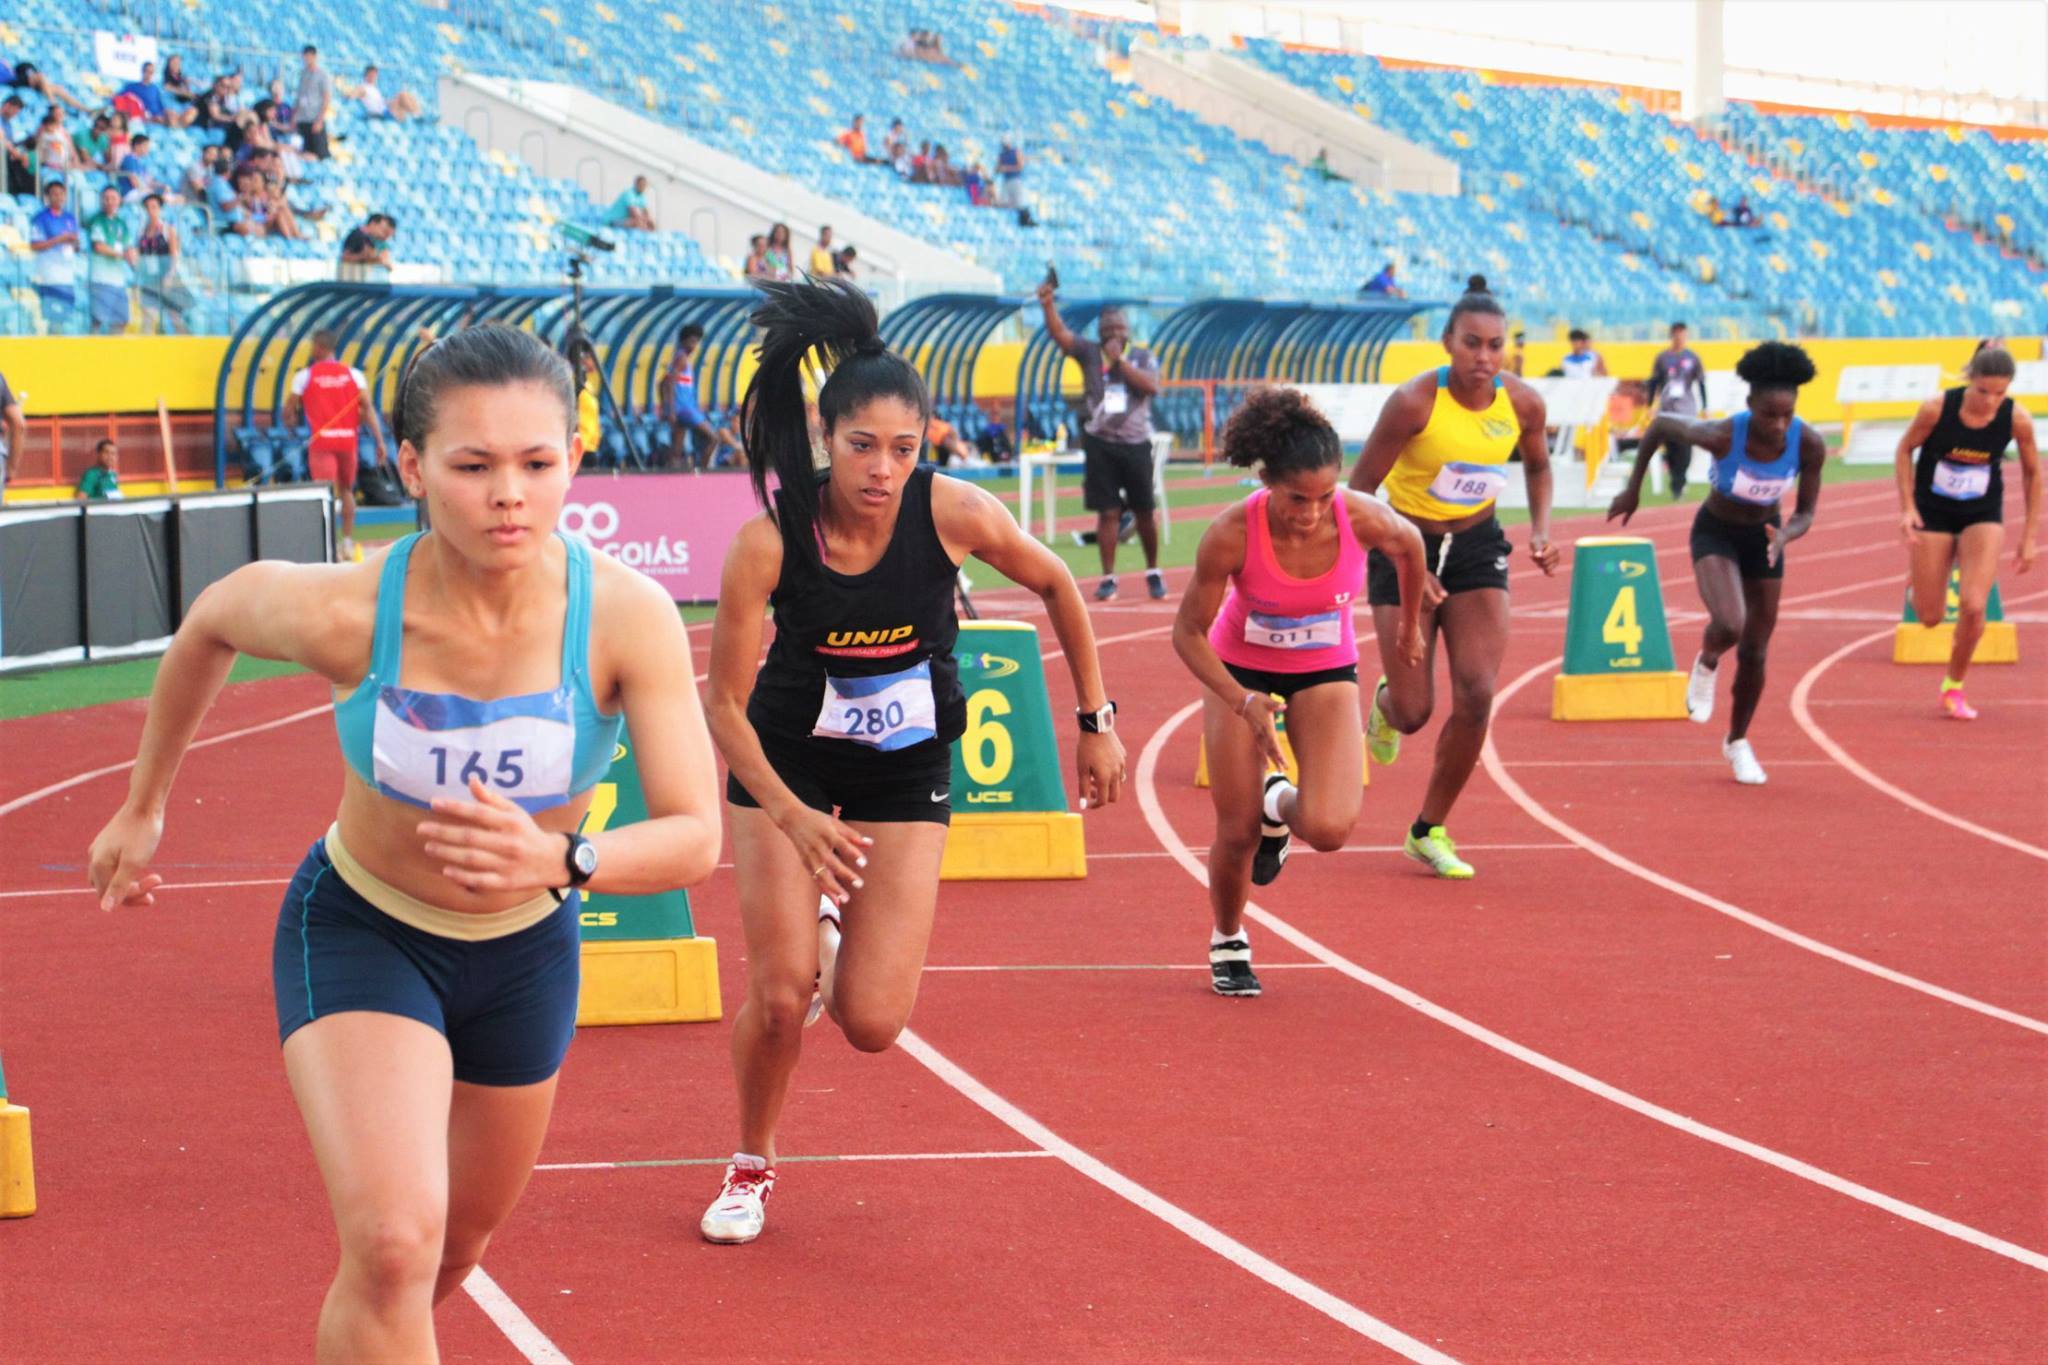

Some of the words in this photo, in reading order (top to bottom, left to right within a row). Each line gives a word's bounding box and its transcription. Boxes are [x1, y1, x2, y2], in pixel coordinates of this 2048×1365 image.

[1453, 478, 1487, 495] 188
[1602, 585, 1643, 655] 4
[827, 625, 913, 647] UNIP
[1269, 629, 1313, 643] 011
[844, 700, 905, 736] 280
[961, 688, 1014, 786] 6
[429, 747, 524, 789] 165
[966, 791, 1014, 803] UCS
[579, 912, 618, 927] CS
